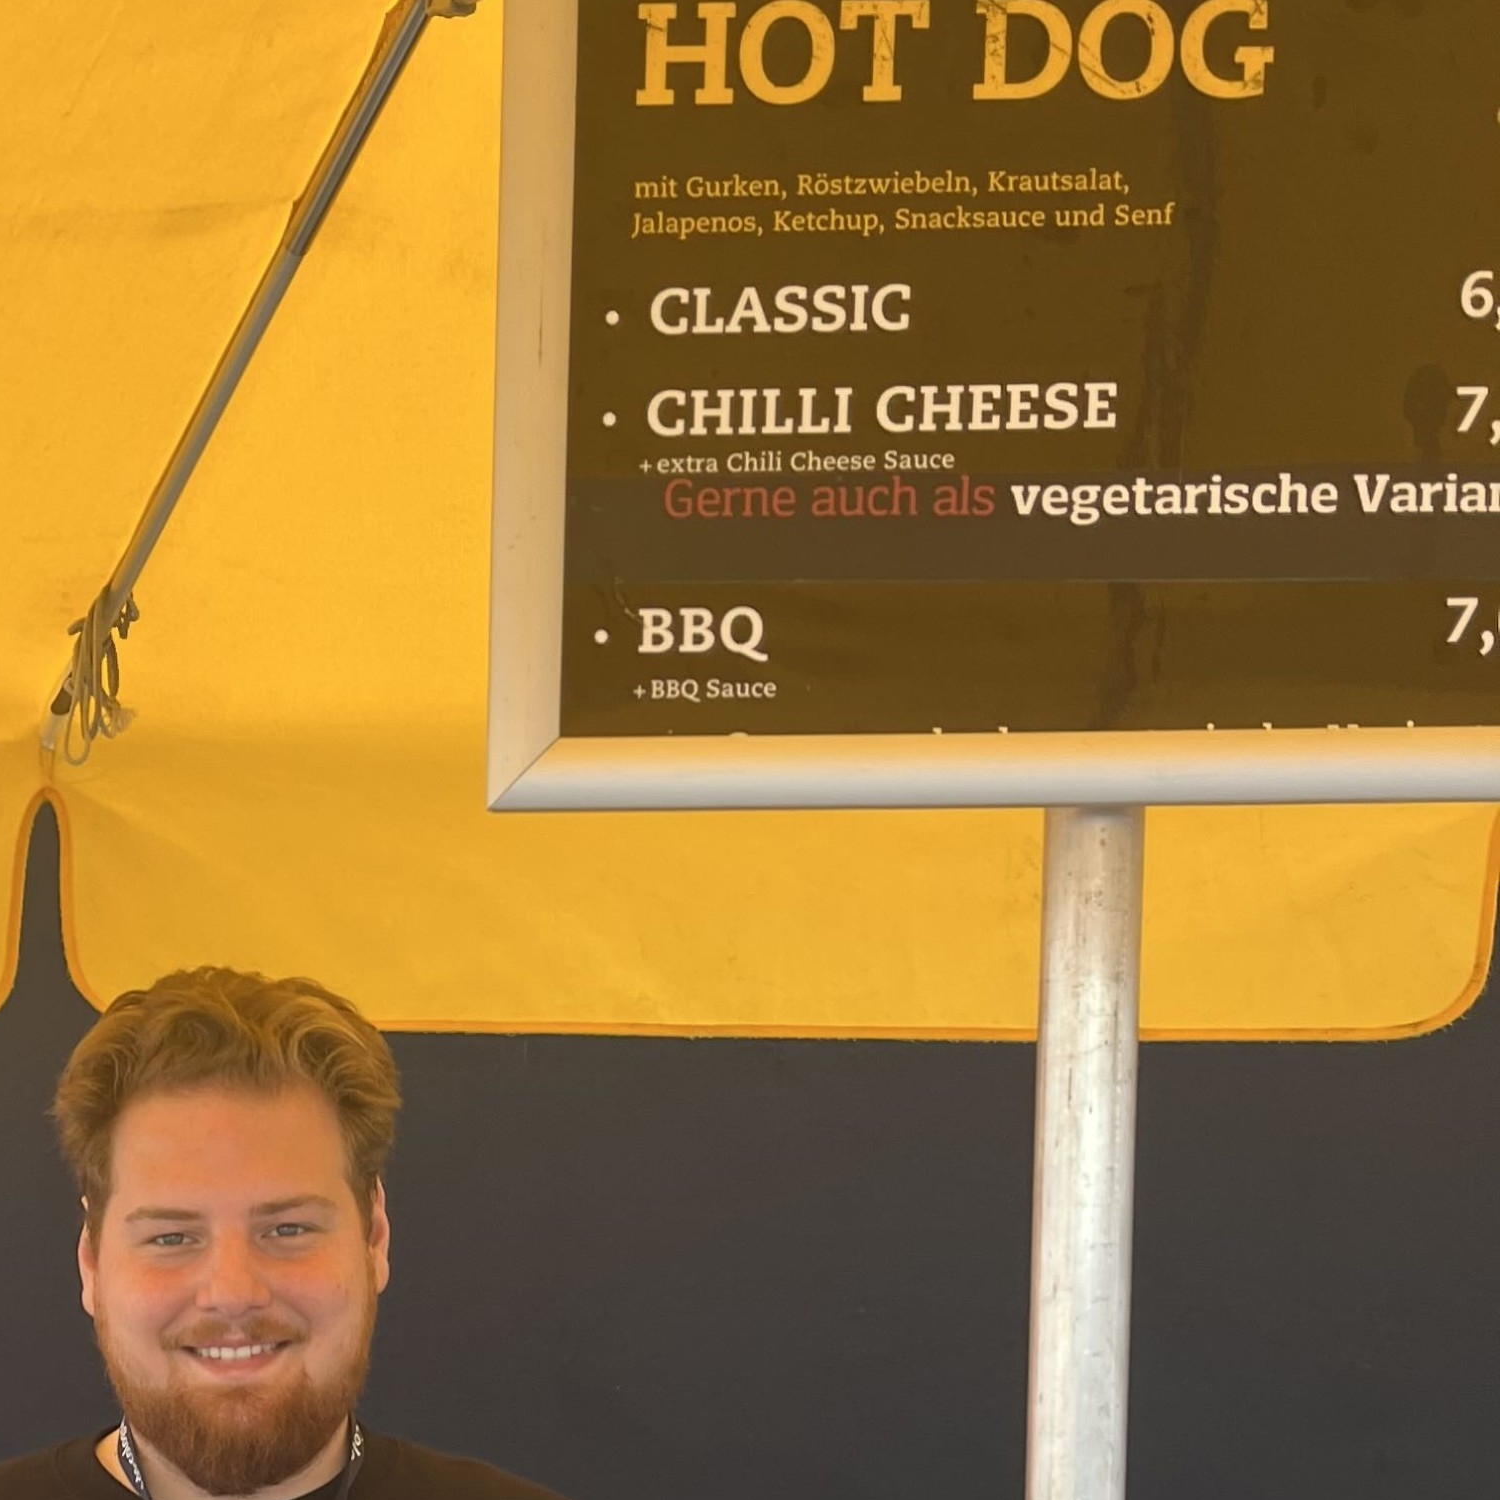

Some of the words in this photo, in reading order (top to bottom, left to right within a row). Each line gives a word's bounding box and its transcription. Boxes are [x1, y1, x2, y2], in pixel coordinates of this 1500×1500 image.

[635, 0, 930, 106] HOT
[972, 0, 1275, 100] DOG
[634, 175, 678, 199] mit
[686, 173, 787, 200] Gurken,
[797, 169, 978, 197] Röstzwiebeln,
[988, 167, 1129, 195] Krautsalat,
[631, 211, 763, 240] Jalapenos,
[773, 207, 885, 237] Ketchup,
[895, 205, 1046, 230] Snacksauce
[1055, 203, 1105, 227] und
[1114, 201, 1176, 226] Senf
[650, 283, 911, 335] CLASSIC
[647, 387, 853, 437] CHILLI
[876, 382, 1118, 433] CHEESE
[726, 450, 782, 473] Chili
[790, 450, 876, 472] Cheese
[884, 450, 955, 470] Sauce
[663, 479, 797, 519] Gerne
[811, 475, 918, 517] auch
[934, 474, 995, 518] als
[1010, 472, 1338, 526] vegetarische
[637, 606, 769, 662] BBQ
[1446, 597, 1500, 656] 7,
[706, 678, 777, 699] Sauce
